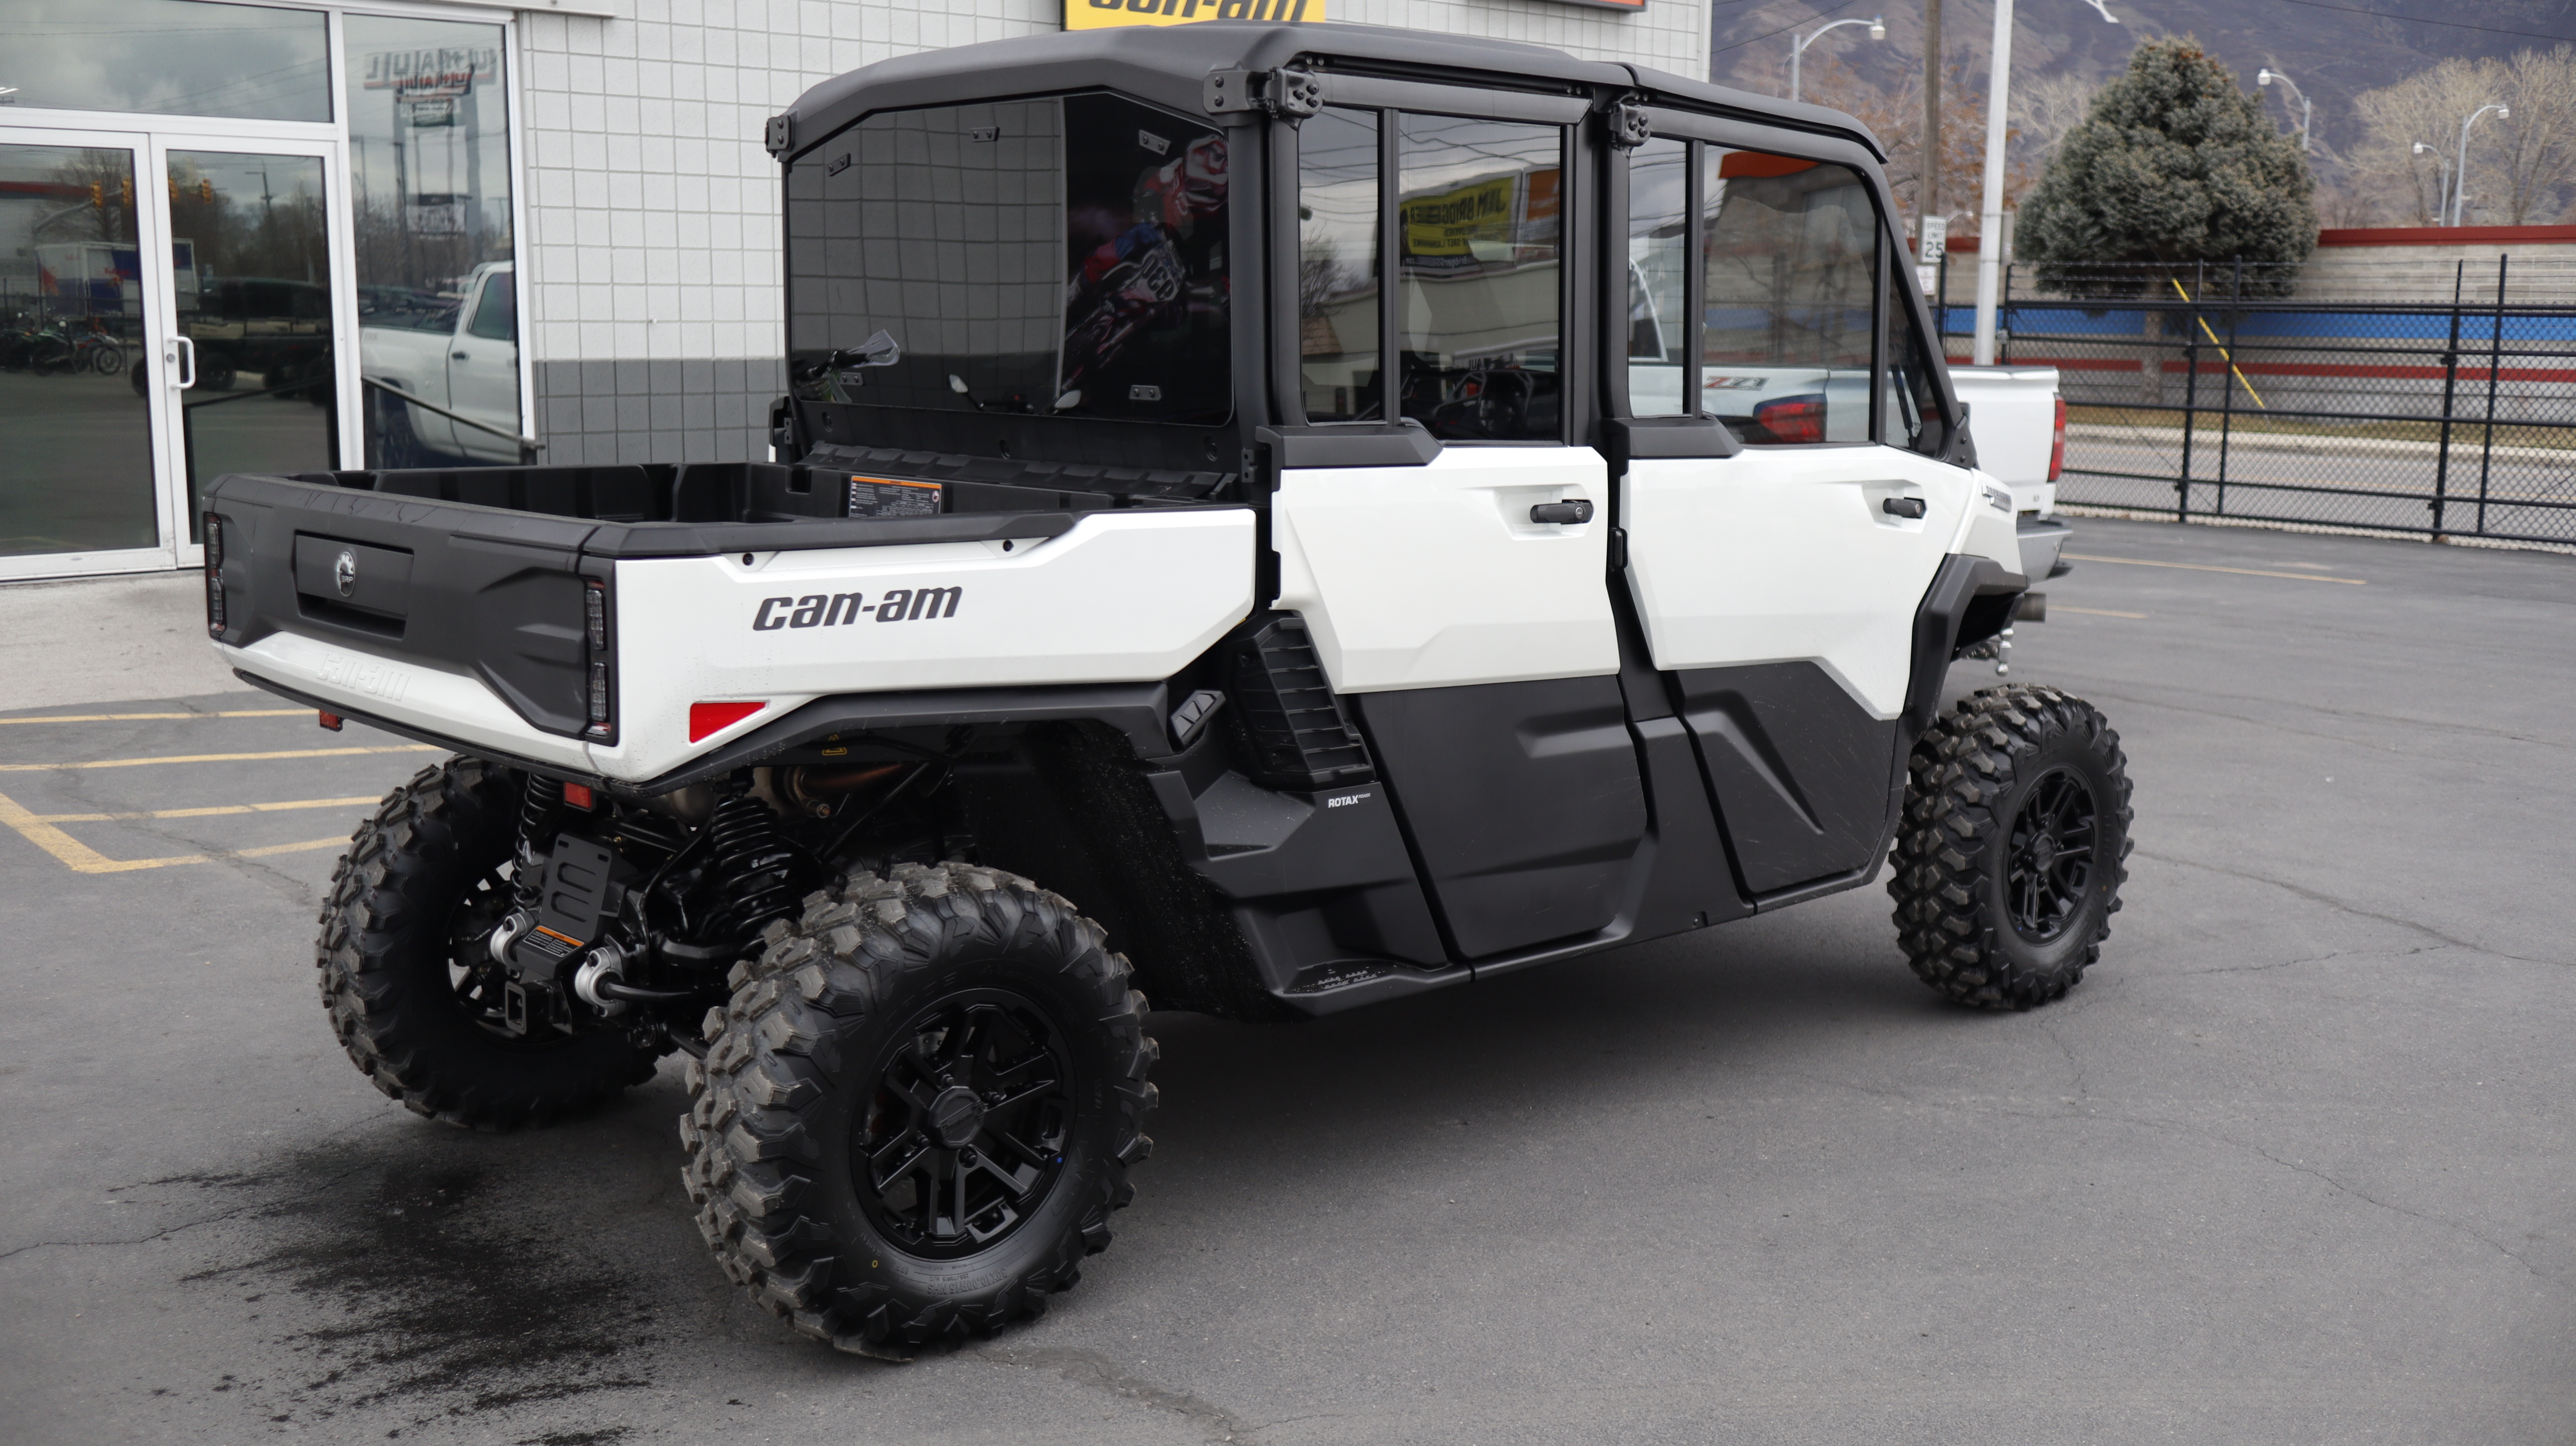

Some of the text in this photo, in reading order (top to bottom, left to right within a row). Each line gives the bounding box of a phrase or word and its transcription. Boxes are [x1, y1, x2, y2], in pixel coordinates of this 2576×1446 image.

[1926, 241, 1944, 258] 25
[1704, 376, 1770, 391] Z71
[341, 575, 353, 583] BRP
[753, 586, 963, 631] can-am
[316, 649, 411, 701] can-am
[1328, 794, 1359, 808] ROTAX
